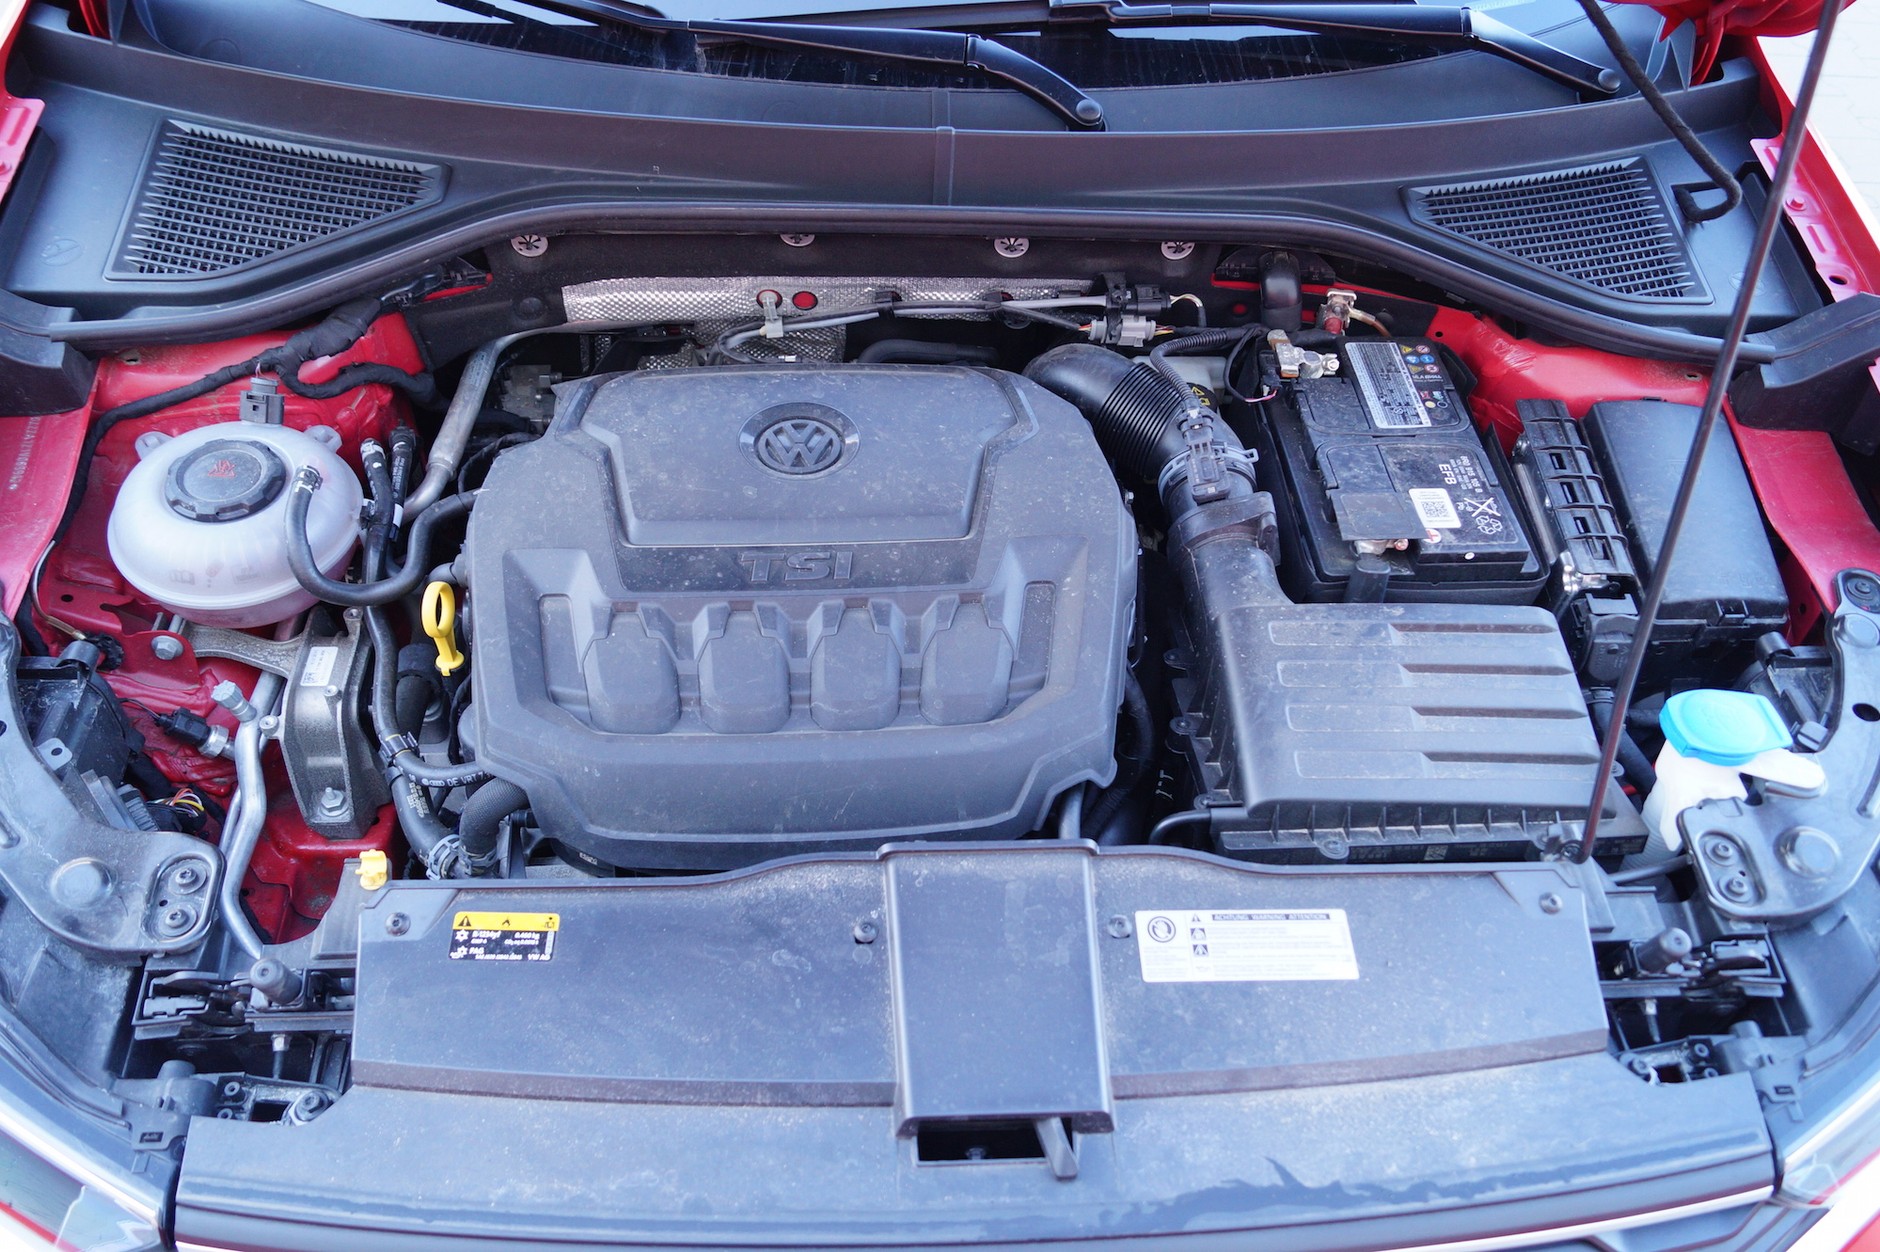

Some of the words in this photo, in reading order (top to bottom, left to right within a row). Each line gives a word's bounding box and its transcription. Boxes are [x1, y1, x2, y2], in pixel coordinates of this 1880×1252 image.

[757, 418, 842, 473] VW
[1438, 463, 1458, 485] EFB
[741, 551, 853, 582] TSI
[446, 777, 459, 786] DE
[461, 773, 477, 784] VRT
